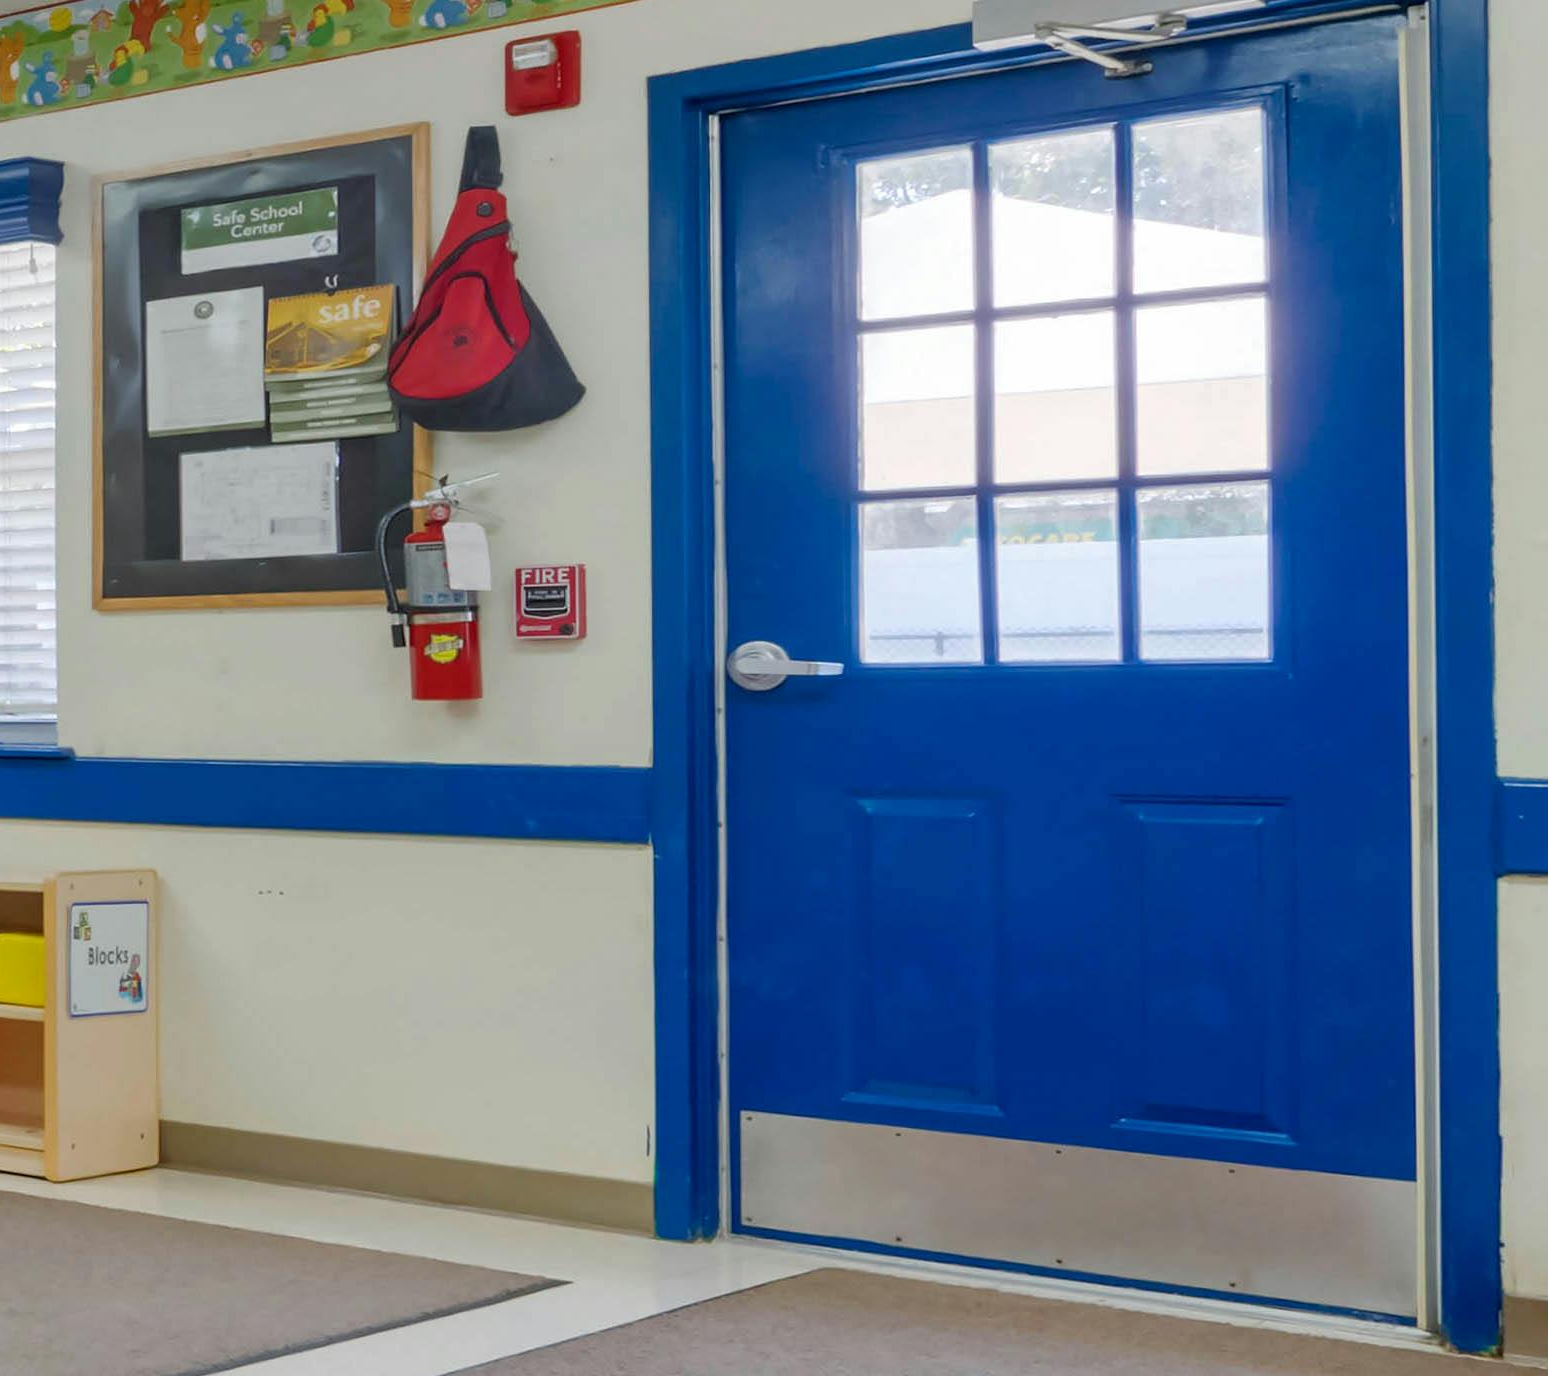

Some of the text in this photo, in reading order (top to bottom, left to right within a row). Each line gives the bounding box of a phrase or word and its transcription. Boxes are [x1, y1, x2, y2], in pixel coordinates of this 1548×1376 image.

[213, 200, 304, 228] Safe School
[230, 221, 285, 239] Center
[317, 295, 381, 324] safe
[520, 567, 570, 584] FIRE
[88, 945, 130, 966] Blocks
